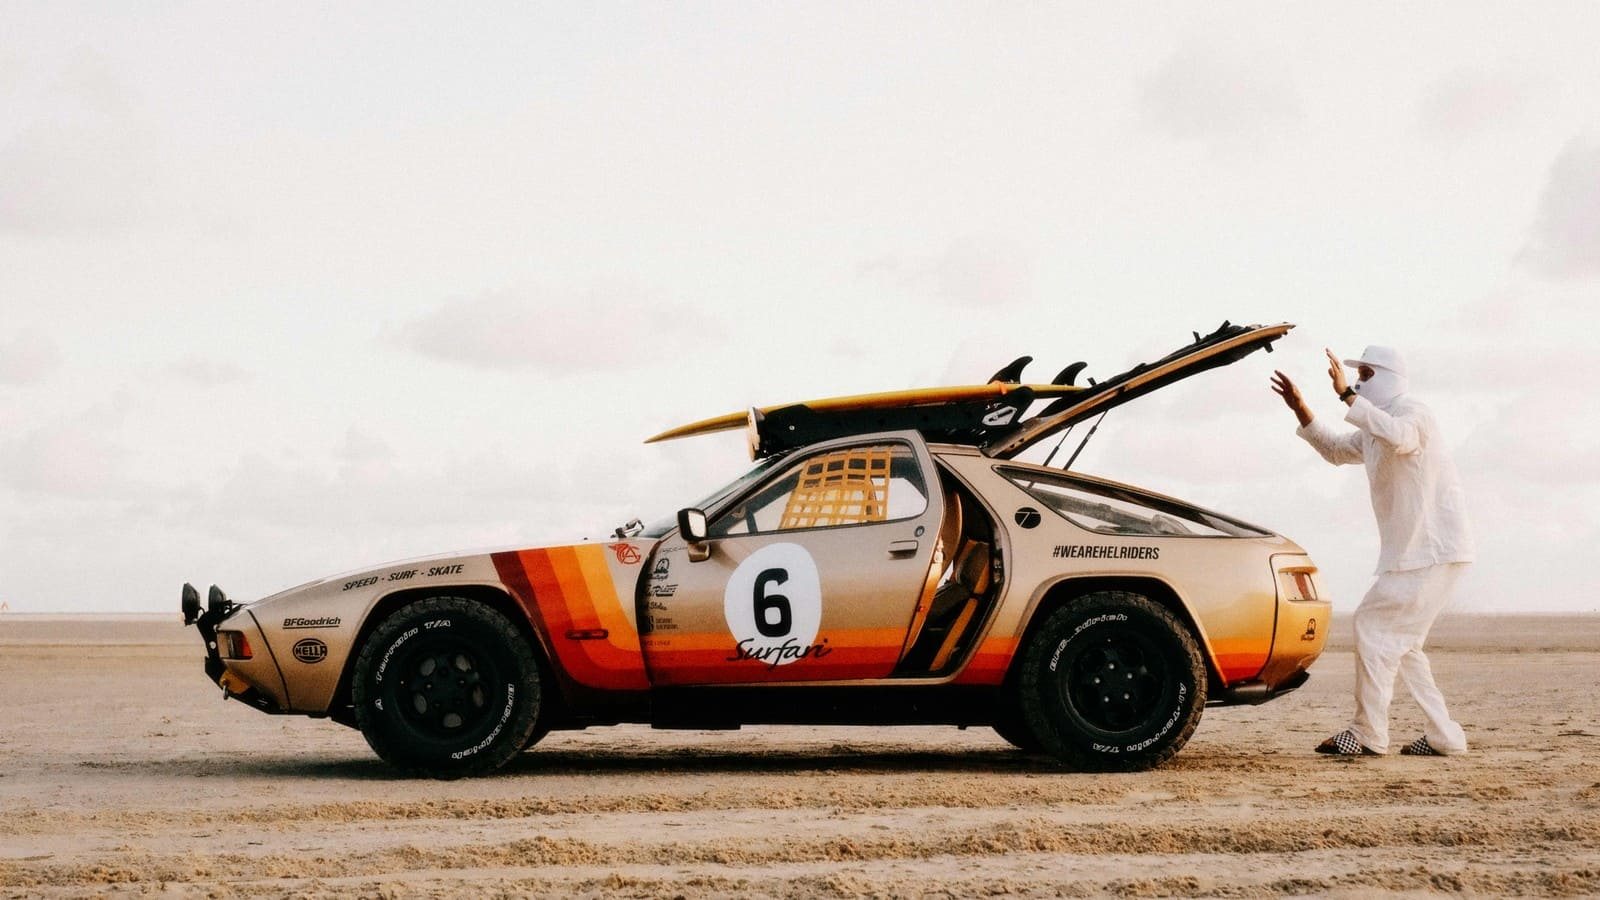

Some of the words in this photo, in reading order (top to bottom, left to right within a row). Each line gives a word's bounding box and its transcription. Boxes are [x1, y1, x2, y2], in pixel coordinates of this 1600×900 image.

[1053, 545, 1160, 560] #WEAREHELRIDERS
[342, 576, 379, 591] SPEED
[388, 569, 418, 582] SURF
[427, 564, 464, 577] SKATE
[753, 568, 792, 637] 6
[283, 616, 341, 627] BFGoodrich
[295, 645, 328, 657] HELLA
[726, 637, 833, 671] Surfari
